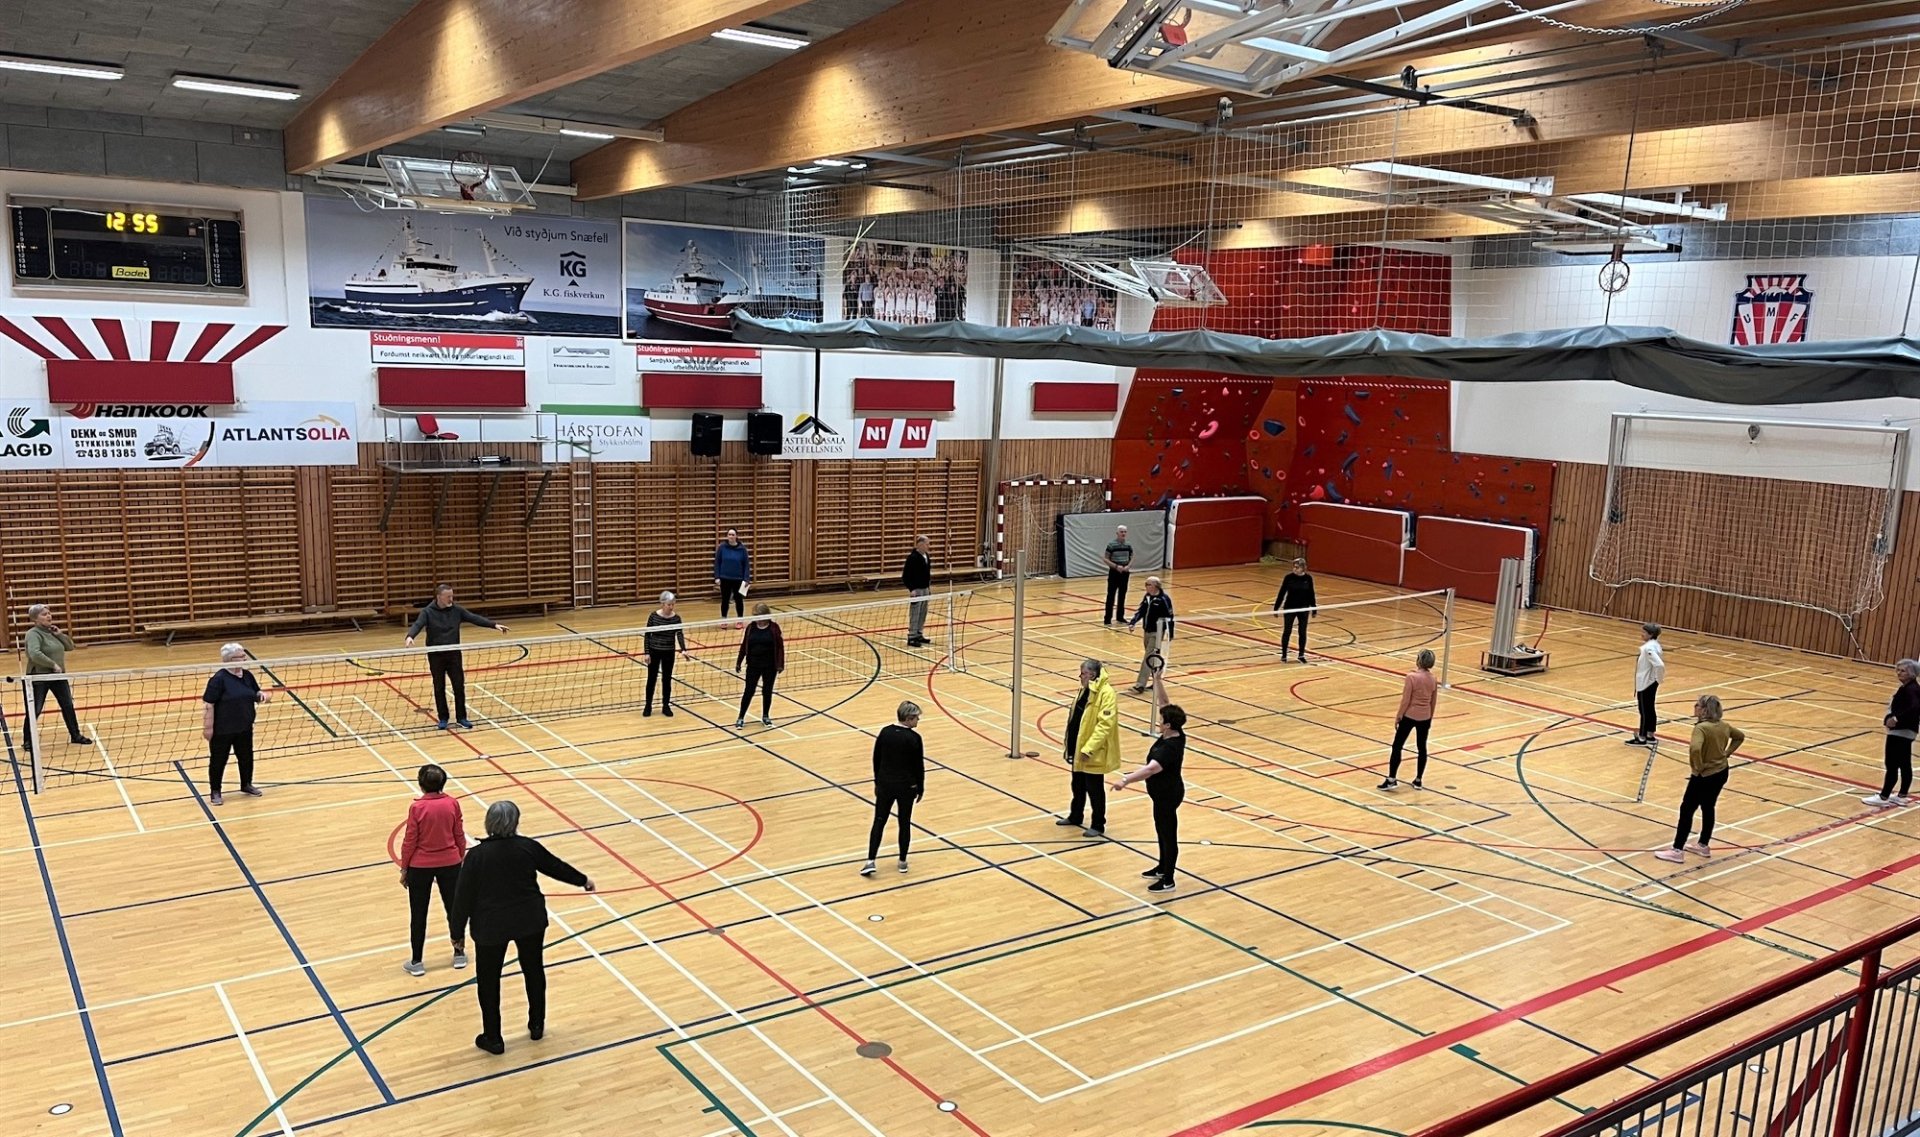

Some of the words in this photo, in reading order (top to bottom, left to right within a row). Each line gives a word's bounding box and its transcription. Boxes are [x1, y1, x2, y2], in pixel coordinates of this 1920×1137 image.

[504, 225, 522, 237] Við
[525, 228, 567, 242] styðjum
[570, 231, 608, 243] Snæfell
[115, 268, 148, 277] Bodet
[560, 260, 586, 277] KG
[543, 289, 562, 297] K.G.
[564, 290, 605, 299] fiskverkun
[373, 333, 441, 344] Stuðningsmenn!
[637, 346, 693, 354] Stuðningsmenn!
[71, 428, 97, 438] DEKK
[108, 428, 137, 438] SMUR
[222, 427, 350, 441] ATLANTSOLIA
[557, 422, 643, 437] HÁRSTOFAN
[866, 426, 886, 440] N1
[907, 426, 926, 440] N1
[75, 439, 135, 448] STYKKISHÓLMI
[87, 448, 108, 458] 438
[110, 448, 137, 458] 1385
[783, 445, 843, 453] SNÆFELLSNESS
